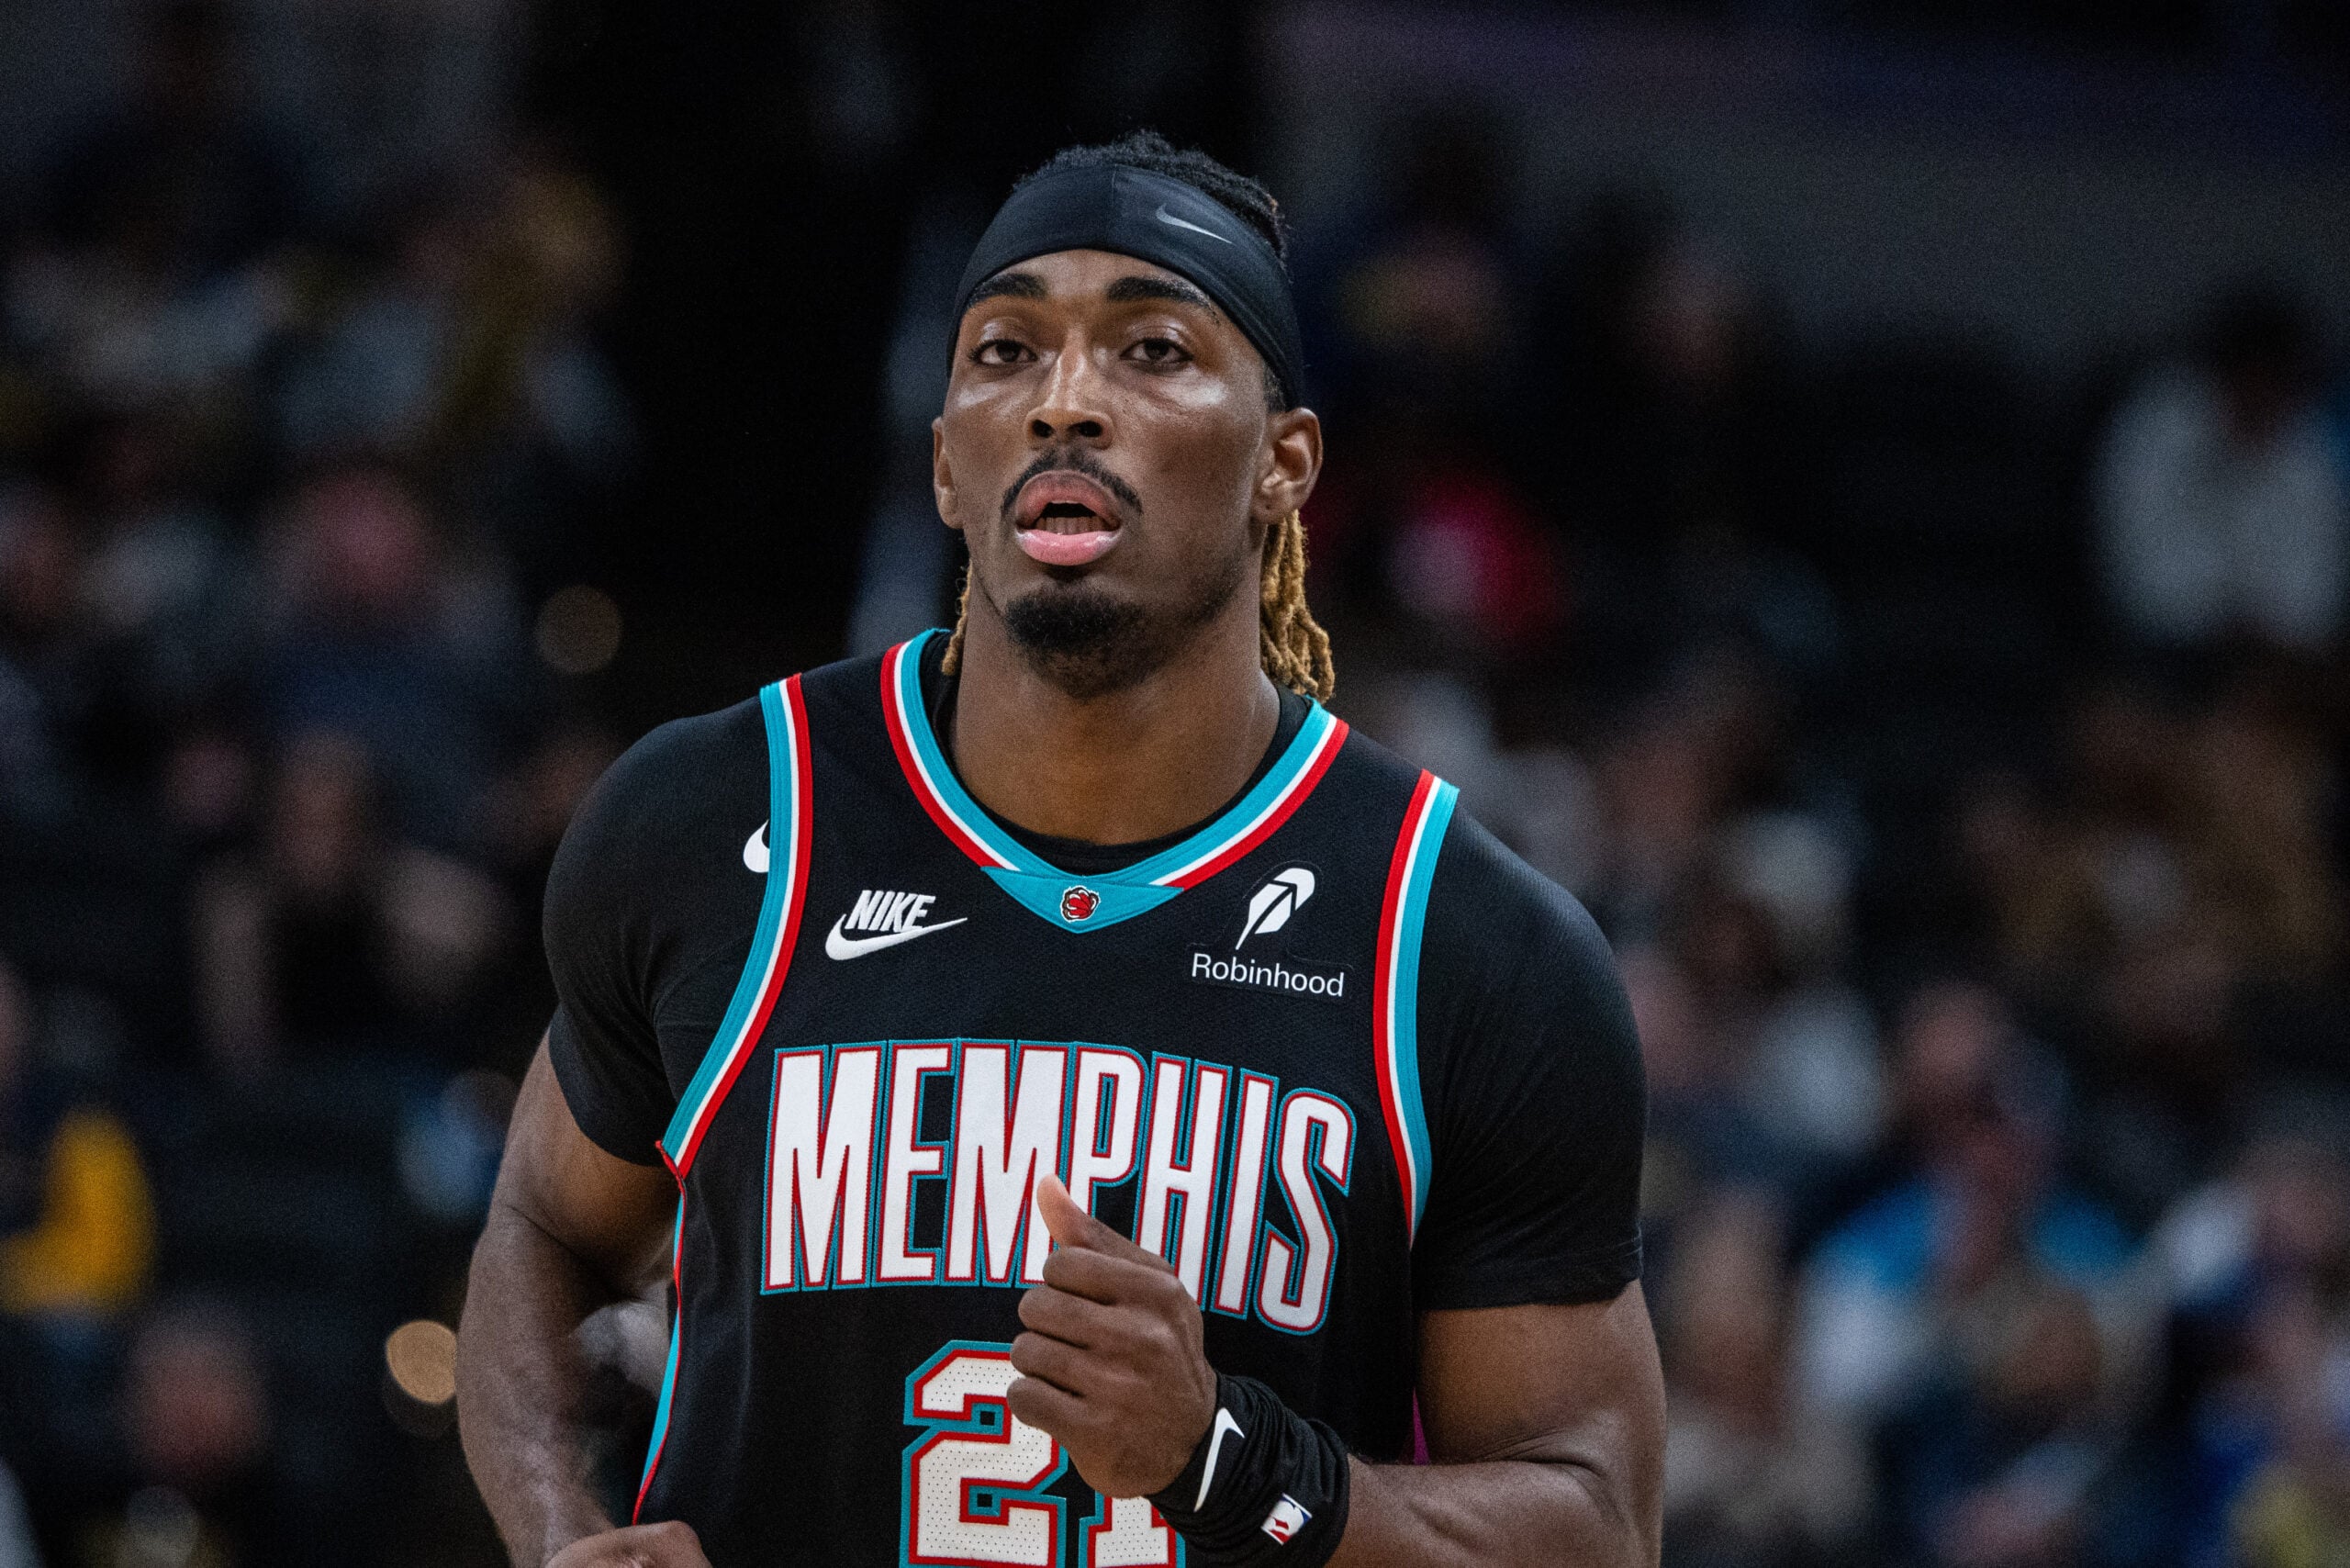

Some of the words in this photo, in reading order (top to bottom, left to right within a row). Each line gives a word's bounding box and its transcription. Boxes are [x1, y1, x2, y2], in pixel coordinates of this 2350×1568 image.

[845, 890, 936, 933] NIKE
[1192, 952, 1345, 997] Robinhood
[761, 1037, 1357, 1336] MEMPHIS
